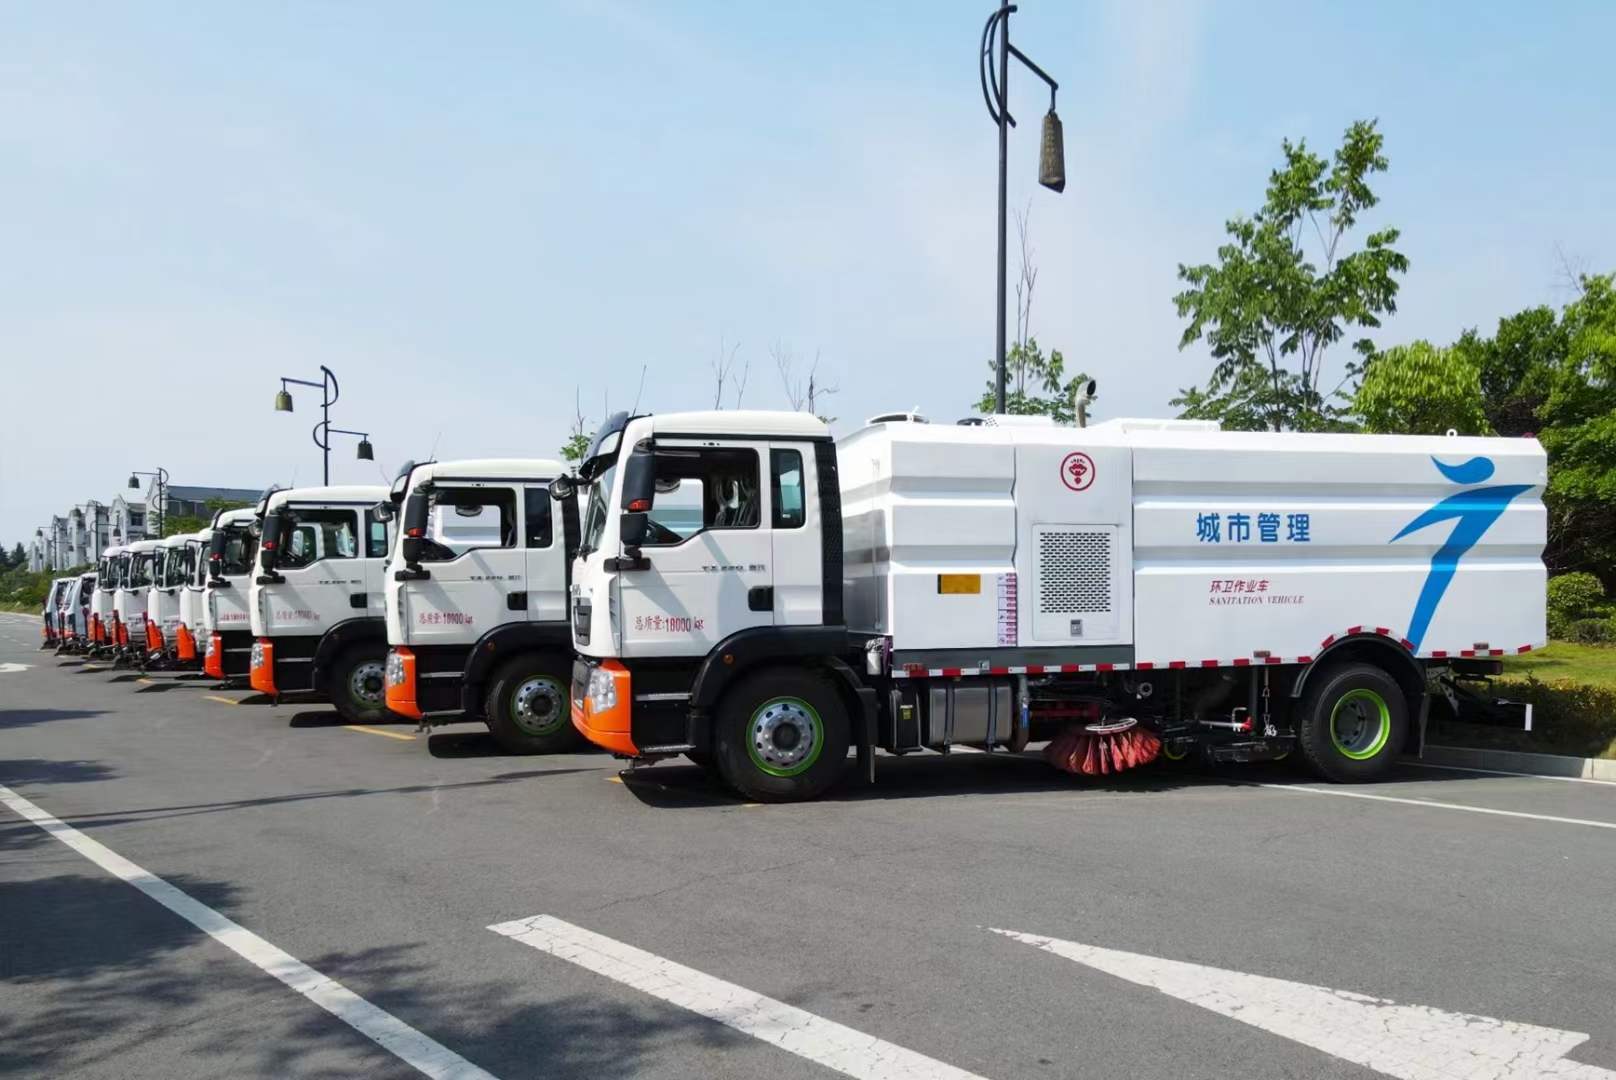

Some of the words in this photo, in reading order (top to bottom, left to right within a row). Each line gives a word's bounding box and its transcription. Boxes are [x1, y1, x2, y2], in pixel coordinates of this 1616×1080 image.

[1196, 512, 1311, 543] 城市管理
[1209, 579, 1270, 593] 环卫作业车
[1209, 596, 1263, 605] SANITATION
[1267, 595, 1304, 604] VEHICLE
